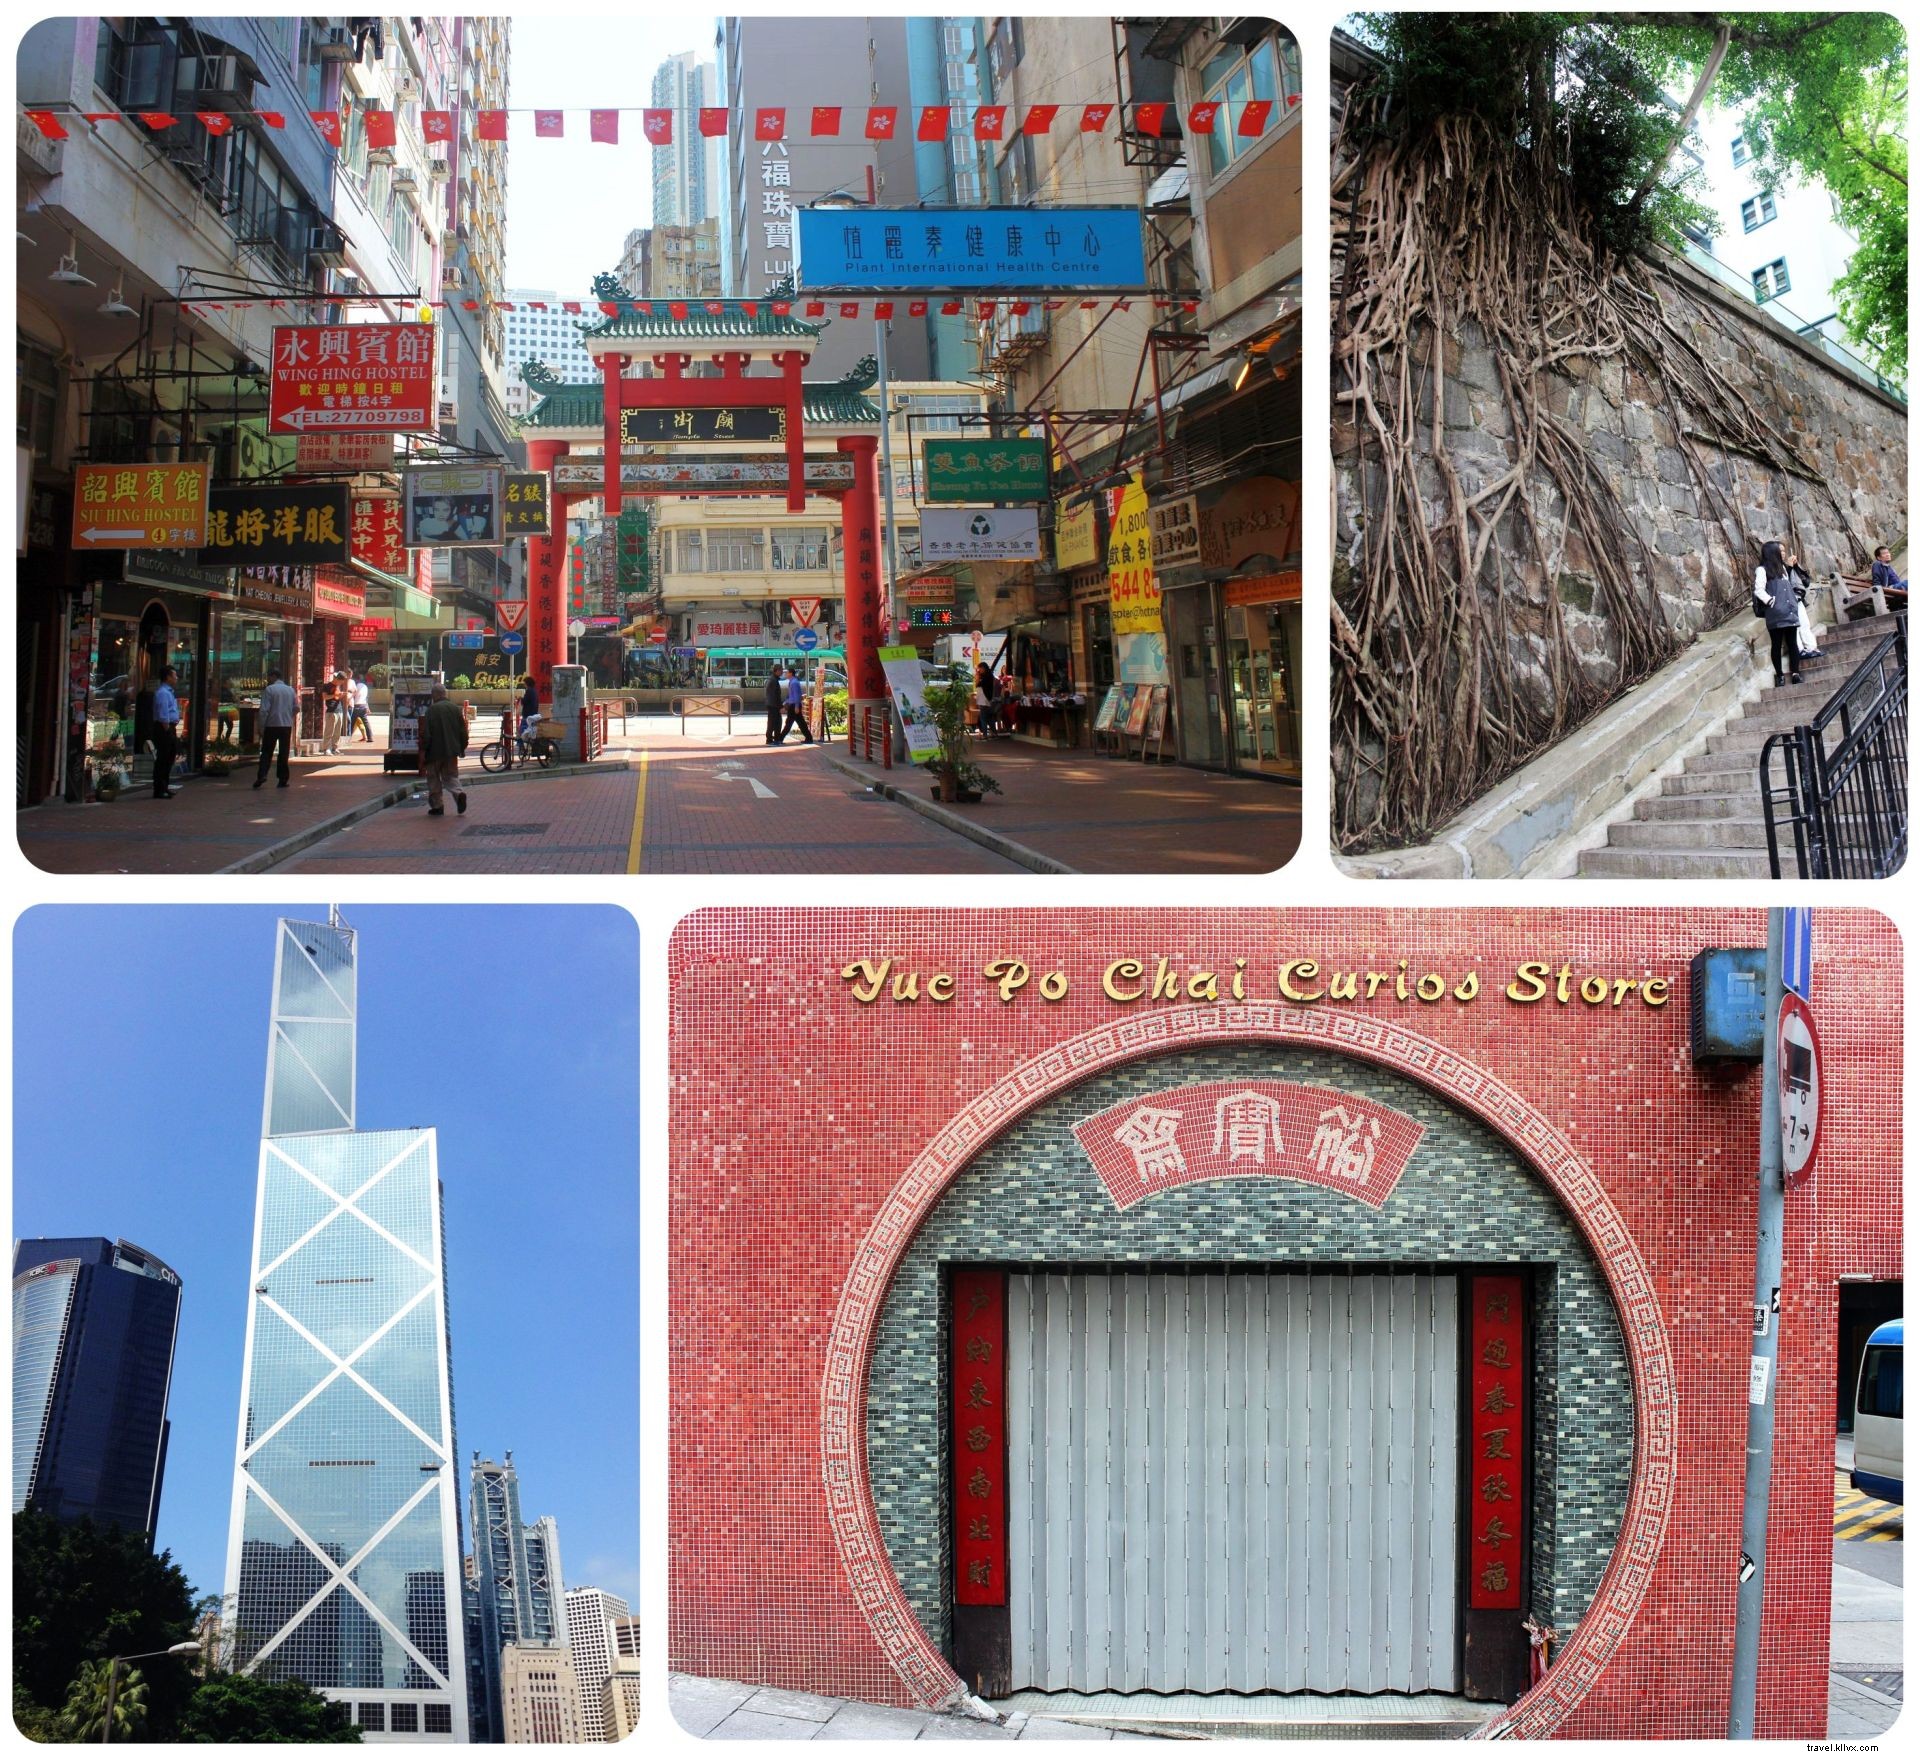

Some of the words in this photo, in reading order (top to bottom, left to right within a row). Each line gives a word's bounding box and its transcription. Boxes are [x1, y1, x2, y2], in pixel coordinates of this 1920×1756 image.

[761, 135, 793, 250] 六福珠寶
[845, 262, 885, 273] Plant
[892, 262, 989, 273] International
[996, 261, 1044, 272] Health
[1051, 262, 1100, 272] Centre
[277, 328, 432, 367] 永興賓館
[277, 368, 318, 382] WING
[323, 367, 362, 381] HING
[366, 366, 428, 380] HOSTEL
[289, 411, 421, 424] TEL:27709798
[79, 509, 104, 523] SIU
[106, 508, 140, 522] HING
[143, 507, 199, 522] HOSTEL
[207, 503, 344, 547] 龍將洋服
[474, 671, 528, 686] Guad
[840, 957, 955, 1002] Yue
[984, 958, 1069, 1003] Po
[1102, 956, 1248, 1002] Chai
[1278, 957, 1480, 1003] Curios
[1506, 960, 1669, 1007] Store
[1789, 1116, 1797, 1139] 7
[1789, 1144, 1796, 1155] m
[29, 1265, 46, 1277] ICBC
